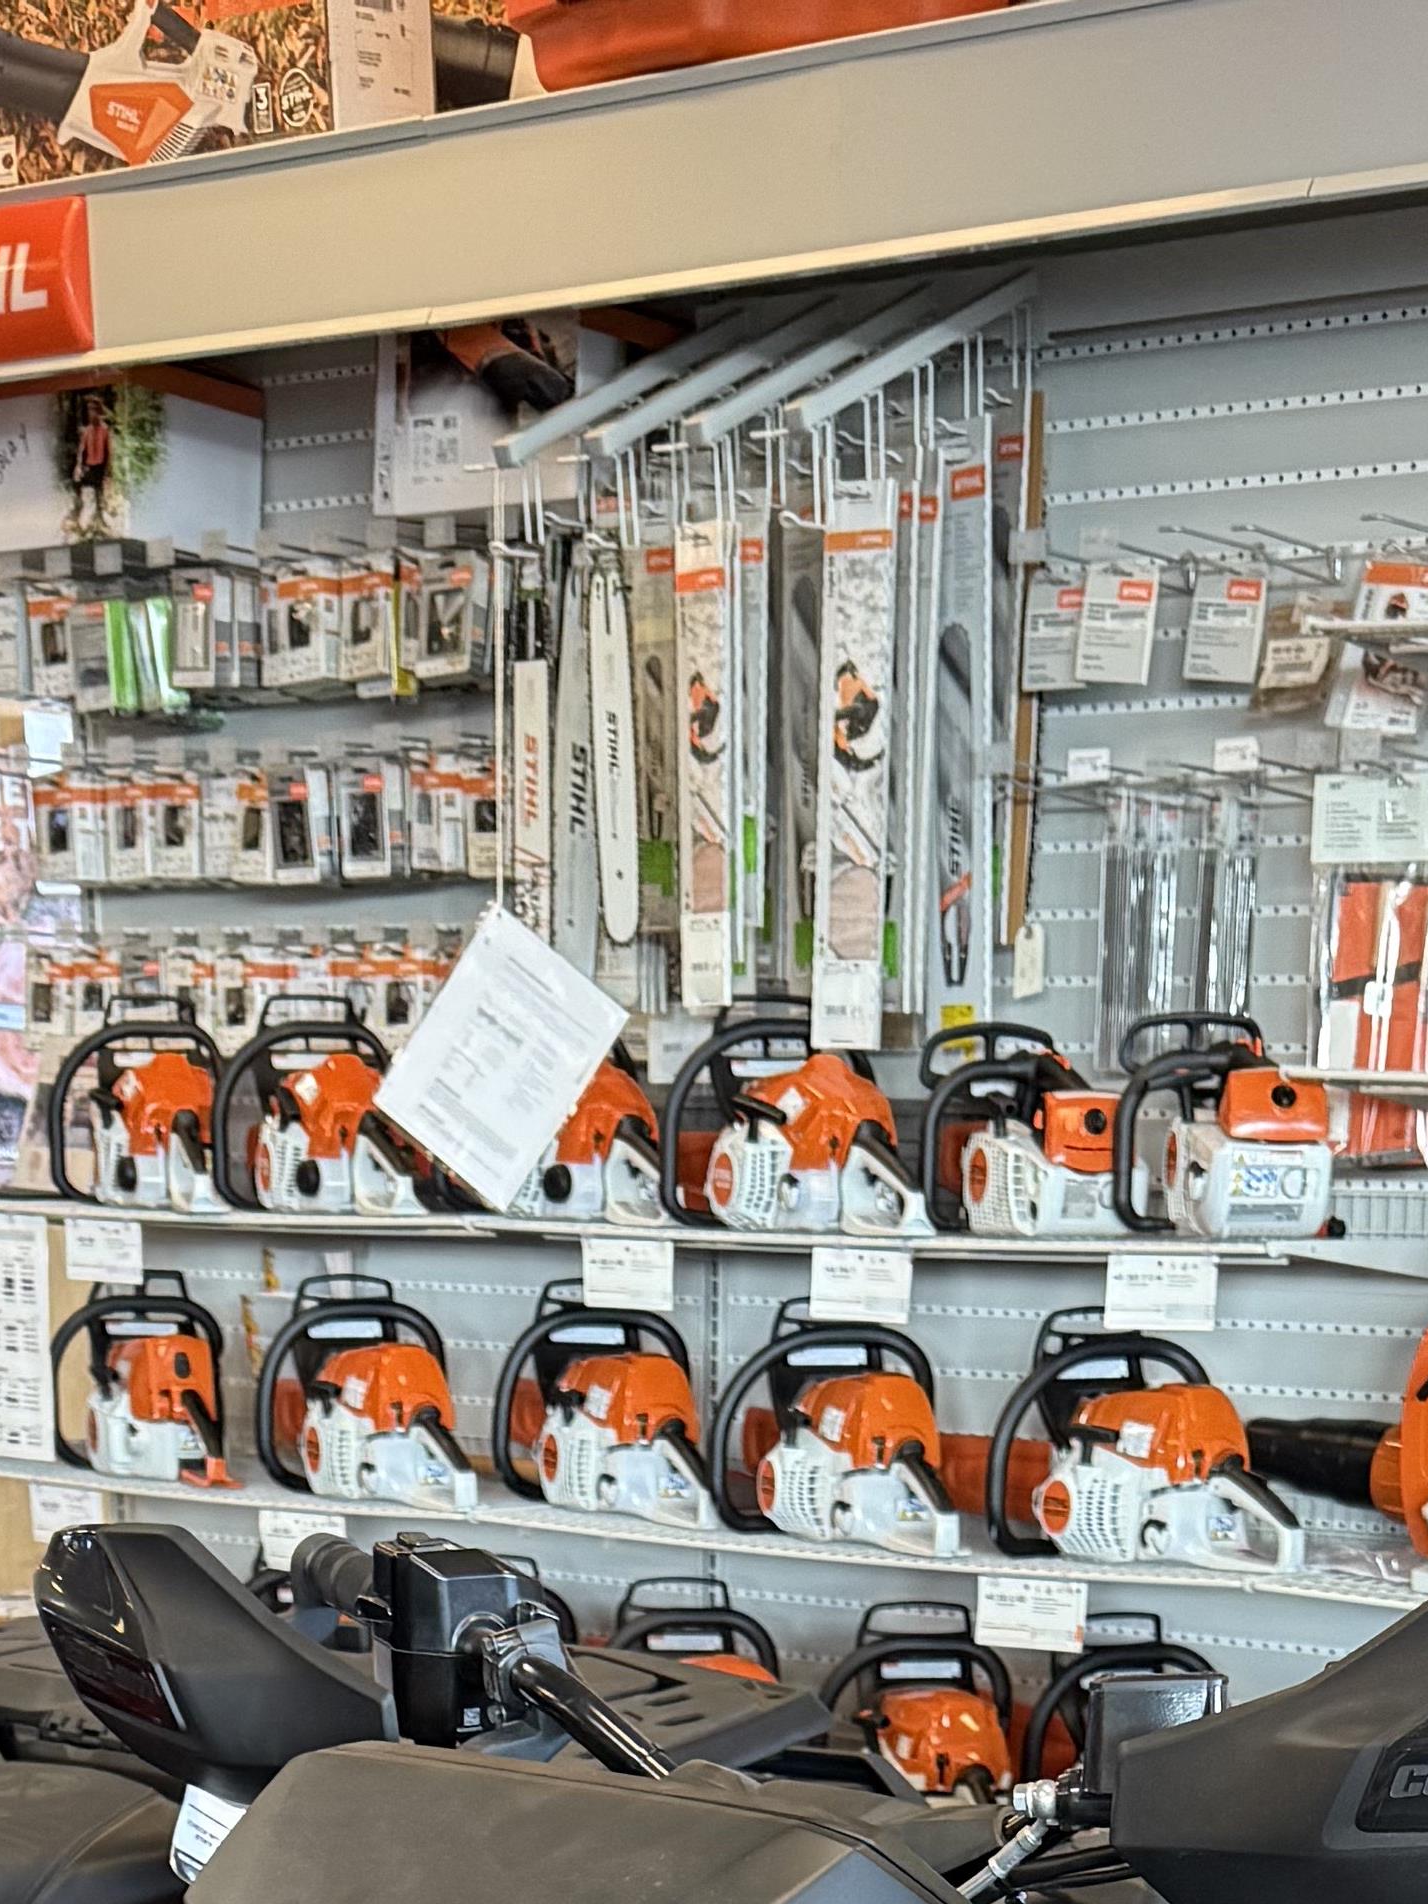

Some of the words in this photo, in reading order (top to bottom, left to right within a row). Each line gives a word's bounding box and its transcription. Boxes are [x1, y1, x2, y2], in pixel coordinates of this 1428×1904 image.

[522, 732, 540, 829] STIHL
[604, 711, 620, 775] STIHL
[570, 741, 588, 838] STIHL
[947, 805, 963, 877] STIHL
